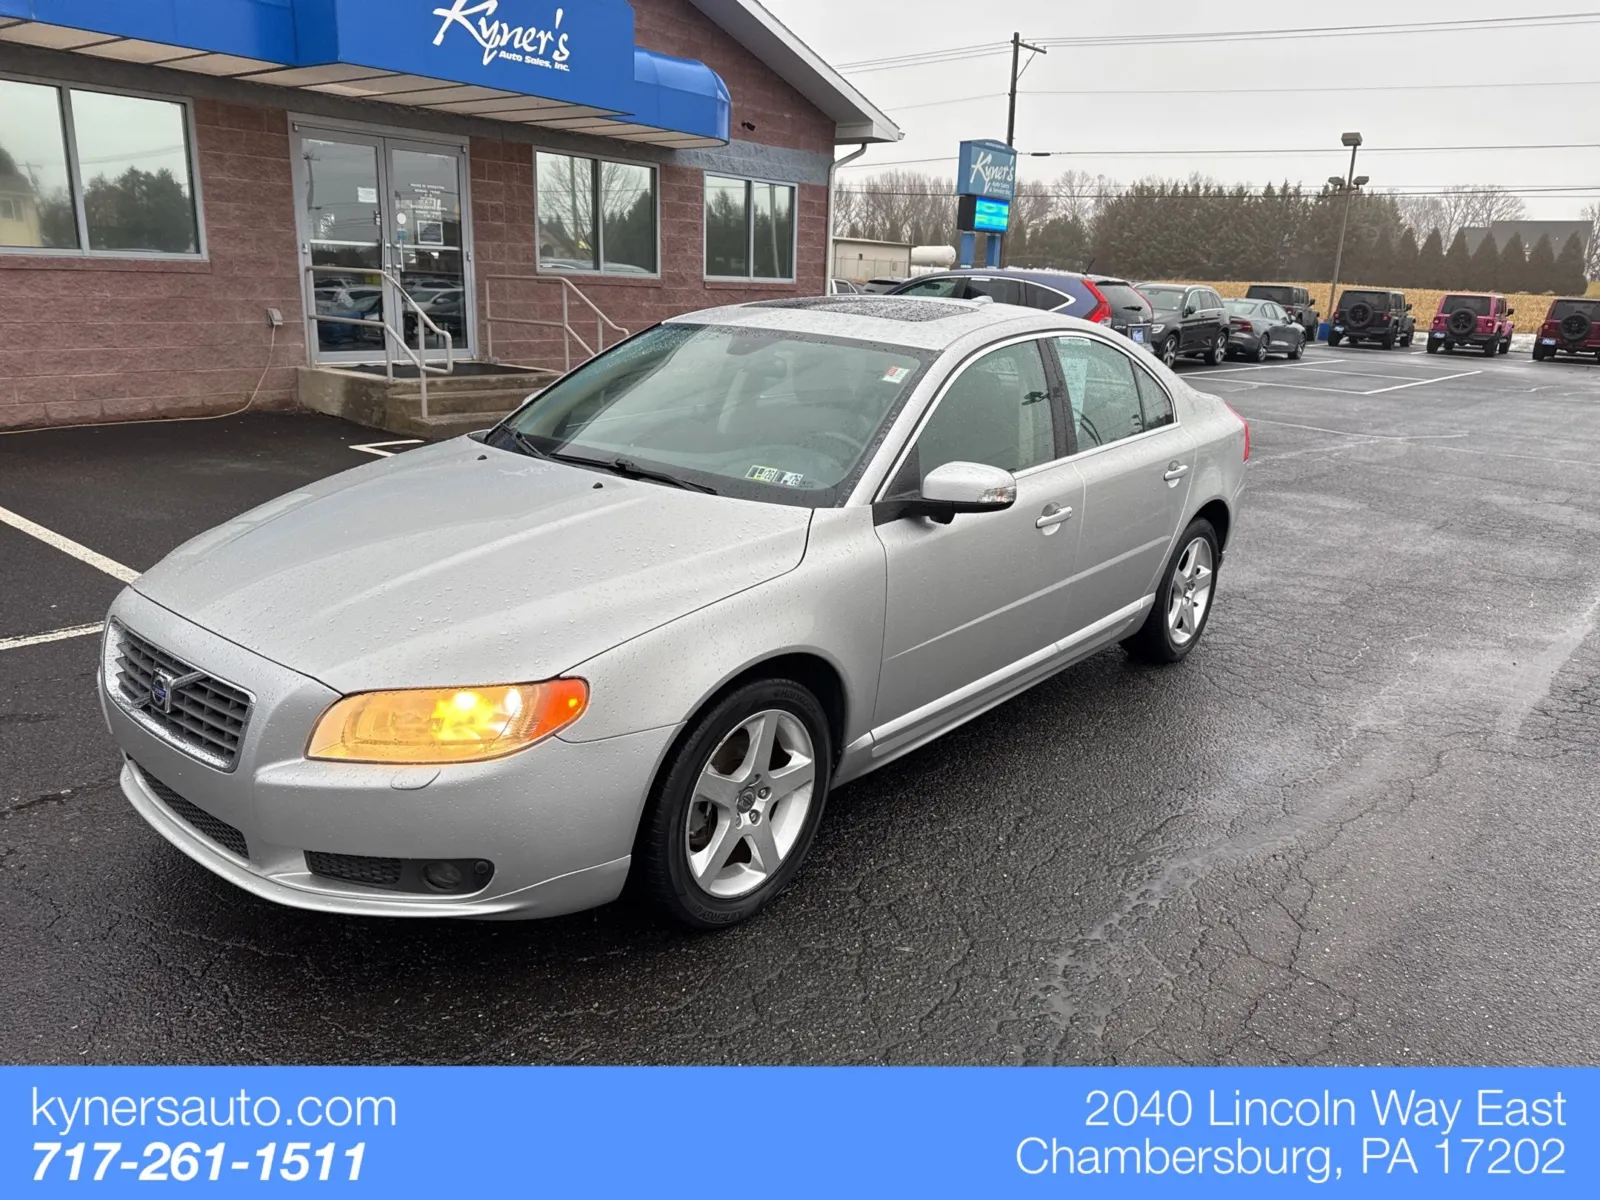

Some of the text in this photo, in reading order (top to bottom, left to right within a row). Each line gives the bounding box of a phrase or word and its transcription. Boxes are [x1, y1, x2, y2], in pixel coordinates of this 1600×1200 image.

[432, 0, 571, 66] Kyner's
[499, 50, 571, 72] Auto Sales, Inc.
[969, 151, 1015, 194] Kyner's
